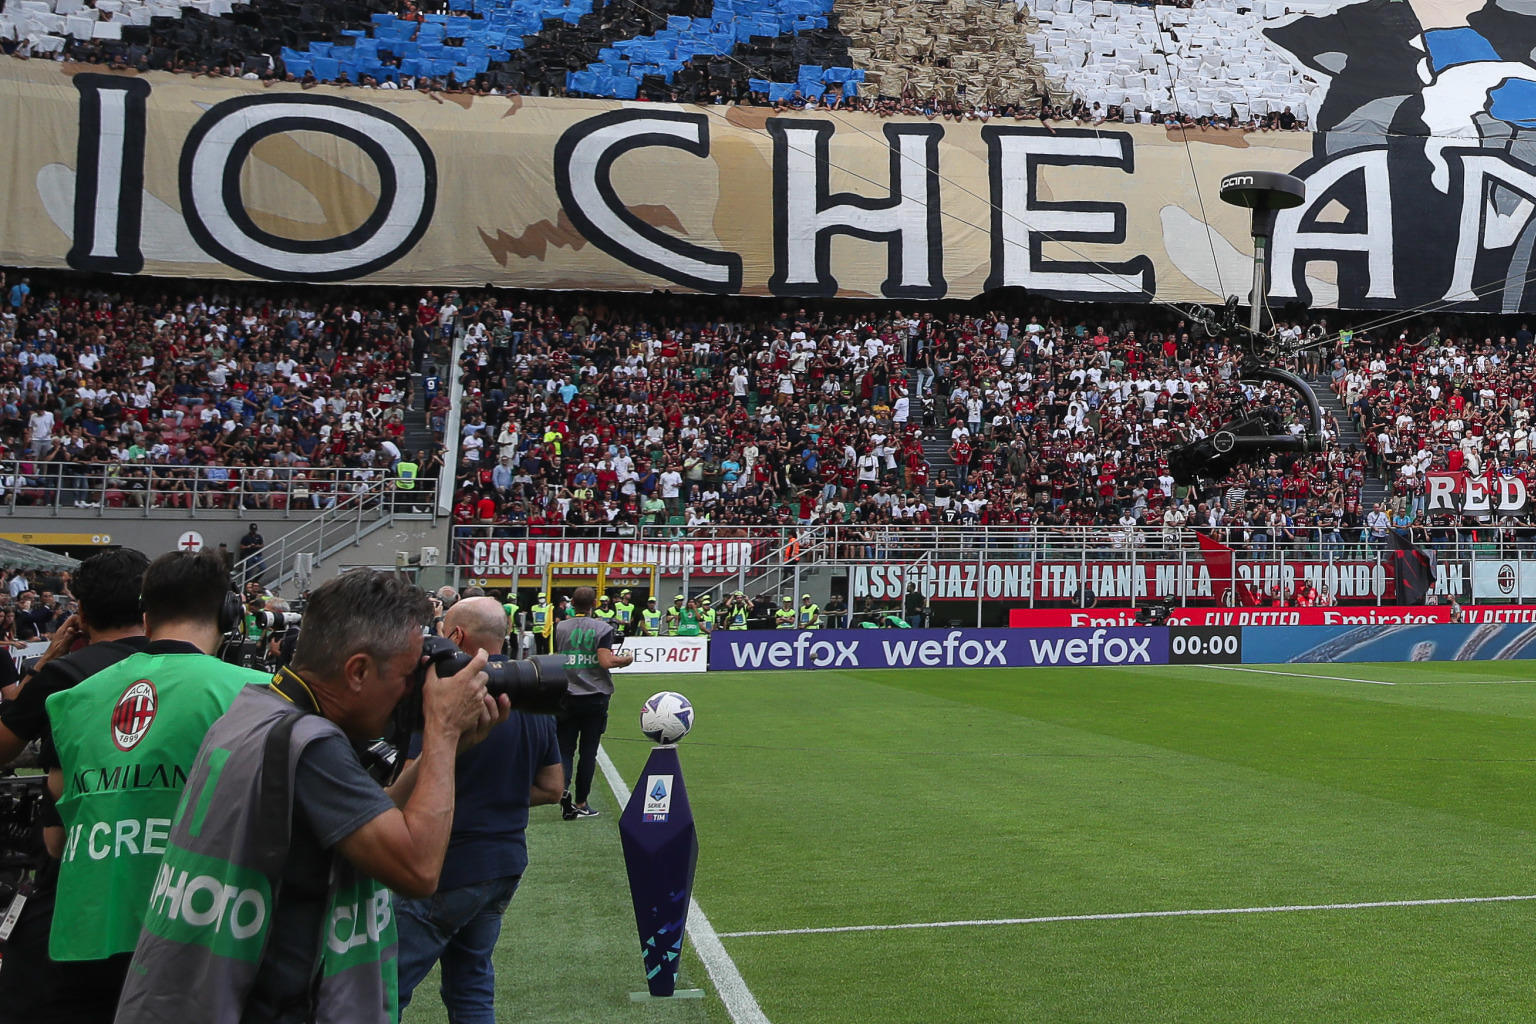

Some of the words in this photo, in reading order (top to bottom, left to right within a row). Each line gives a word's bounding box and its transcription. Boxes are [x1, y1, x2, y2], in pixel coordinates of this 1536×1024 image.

[66, 71, 438, 283] IO
[555, 108, 1155, 303] CHE
[1427, 475, 1526, 512] RED
[473, 541, 528, 575] CASA
[535, 541, 600, 575] MILAN
[621, 542, 695, 575] JUNIOR
[702, 541, 752, 575] CLUB
[1156, 565, 1213, 597] MILA
[1304, 564, 1386, 597] MONDO
[730, 630, 859, 668] wefox
[882, 630, 1007, 666] wefox
[1030, 629, 1151, 664] wefox
[1172, 635, 1238, 656] 00:00
[119, 733, 140, 743] 1899
[96, 763, 191, 790] MILAN
[653, 813, 666, 821] TIM
[88, 817, 172, 860] CRE
[151, 862, 266, 939] PHOTO
